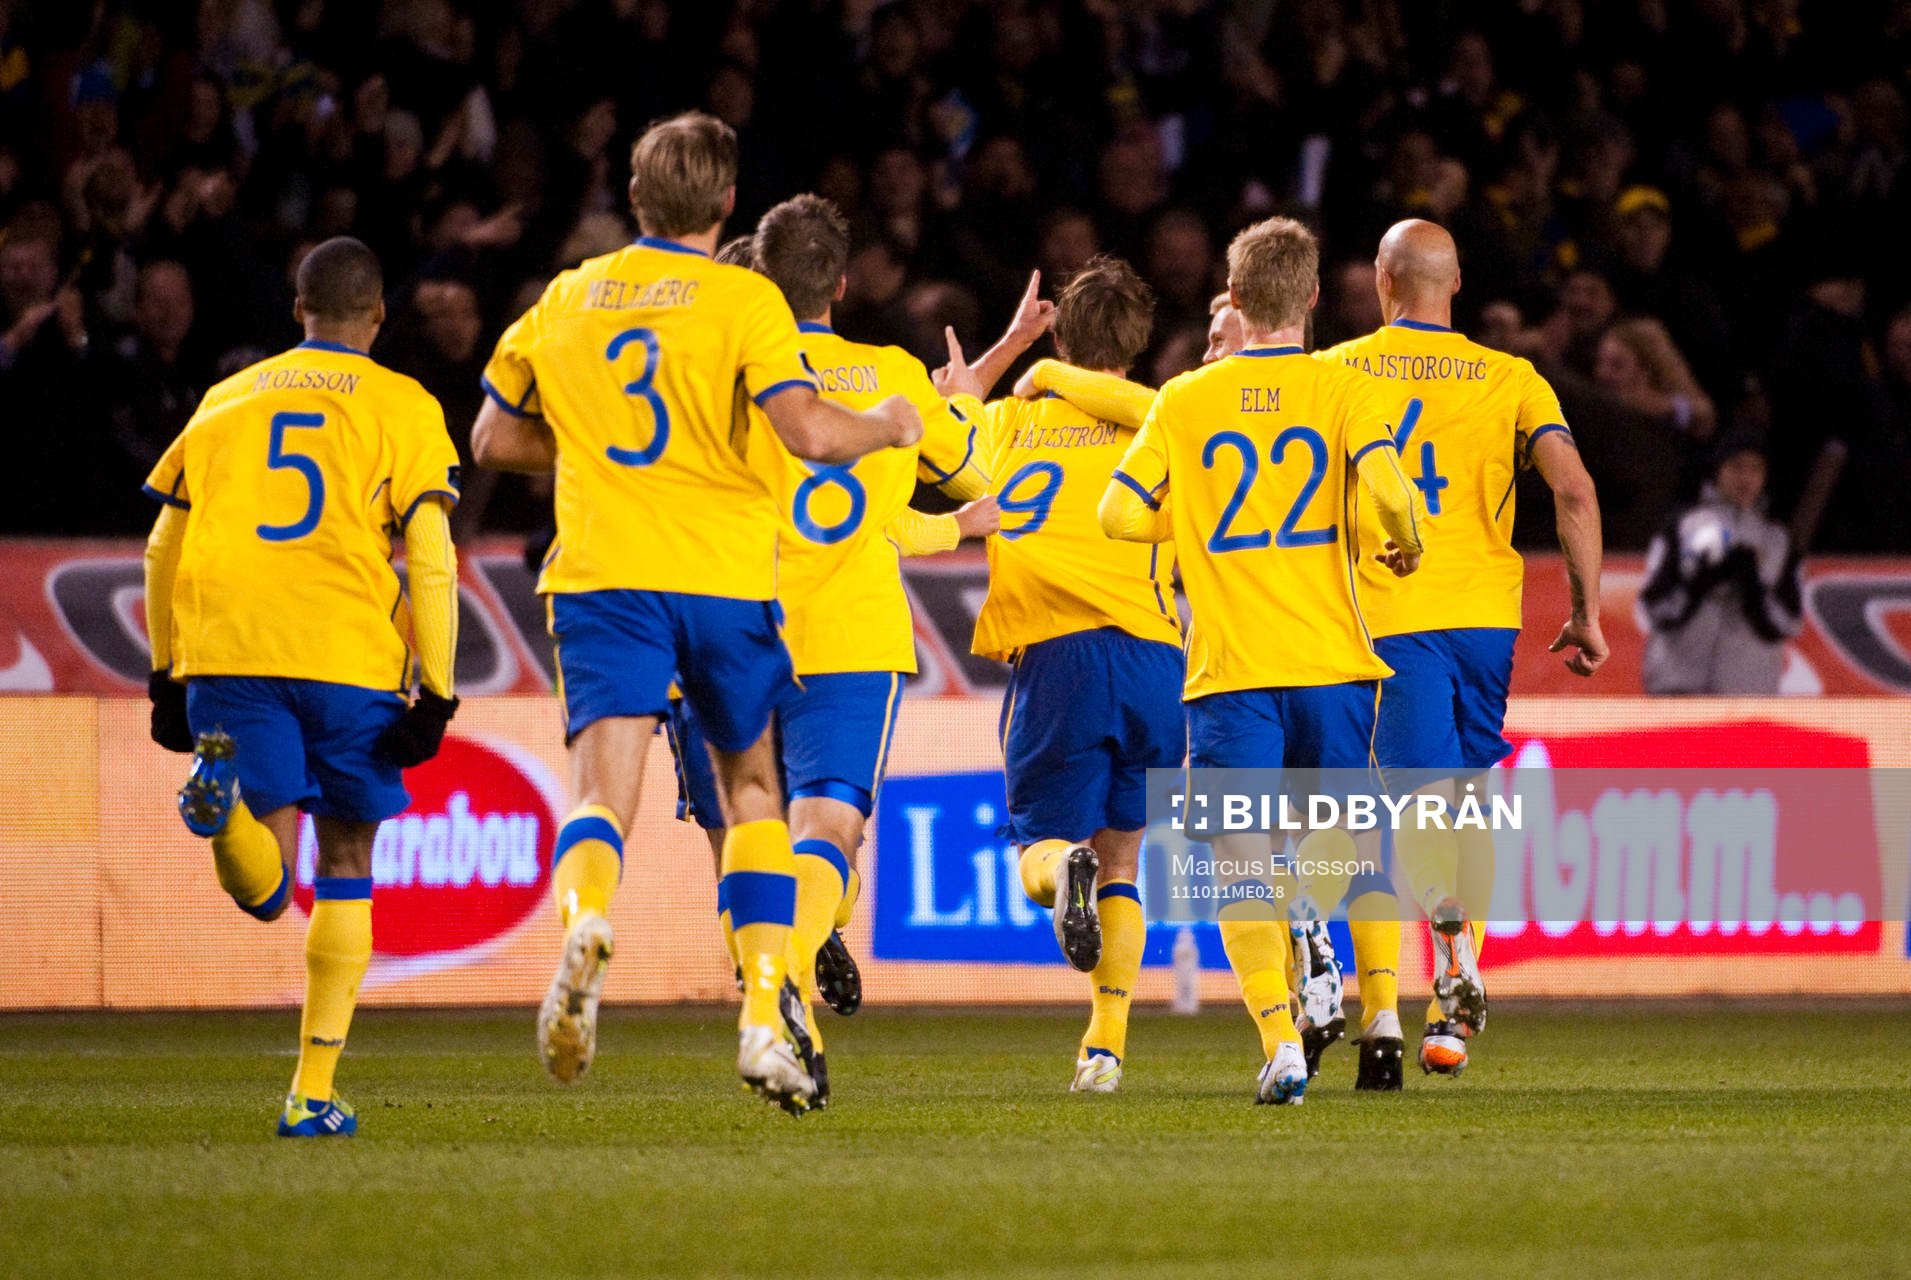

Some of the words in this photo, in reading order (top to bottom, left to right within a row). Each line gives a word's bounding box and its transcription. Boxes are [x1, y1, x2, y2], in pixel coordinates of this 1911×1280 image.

[606, 328, 670, 467] 3
[1240, 387, 1281, 413] ELM
[1394, 397, 1450, 517] 4
[256, 411, 326, 541] 5
[996, 459, 1066, 541] 9
[1201, 425, 1339, 555] 22
[297, 790, 542, 888] arabou
